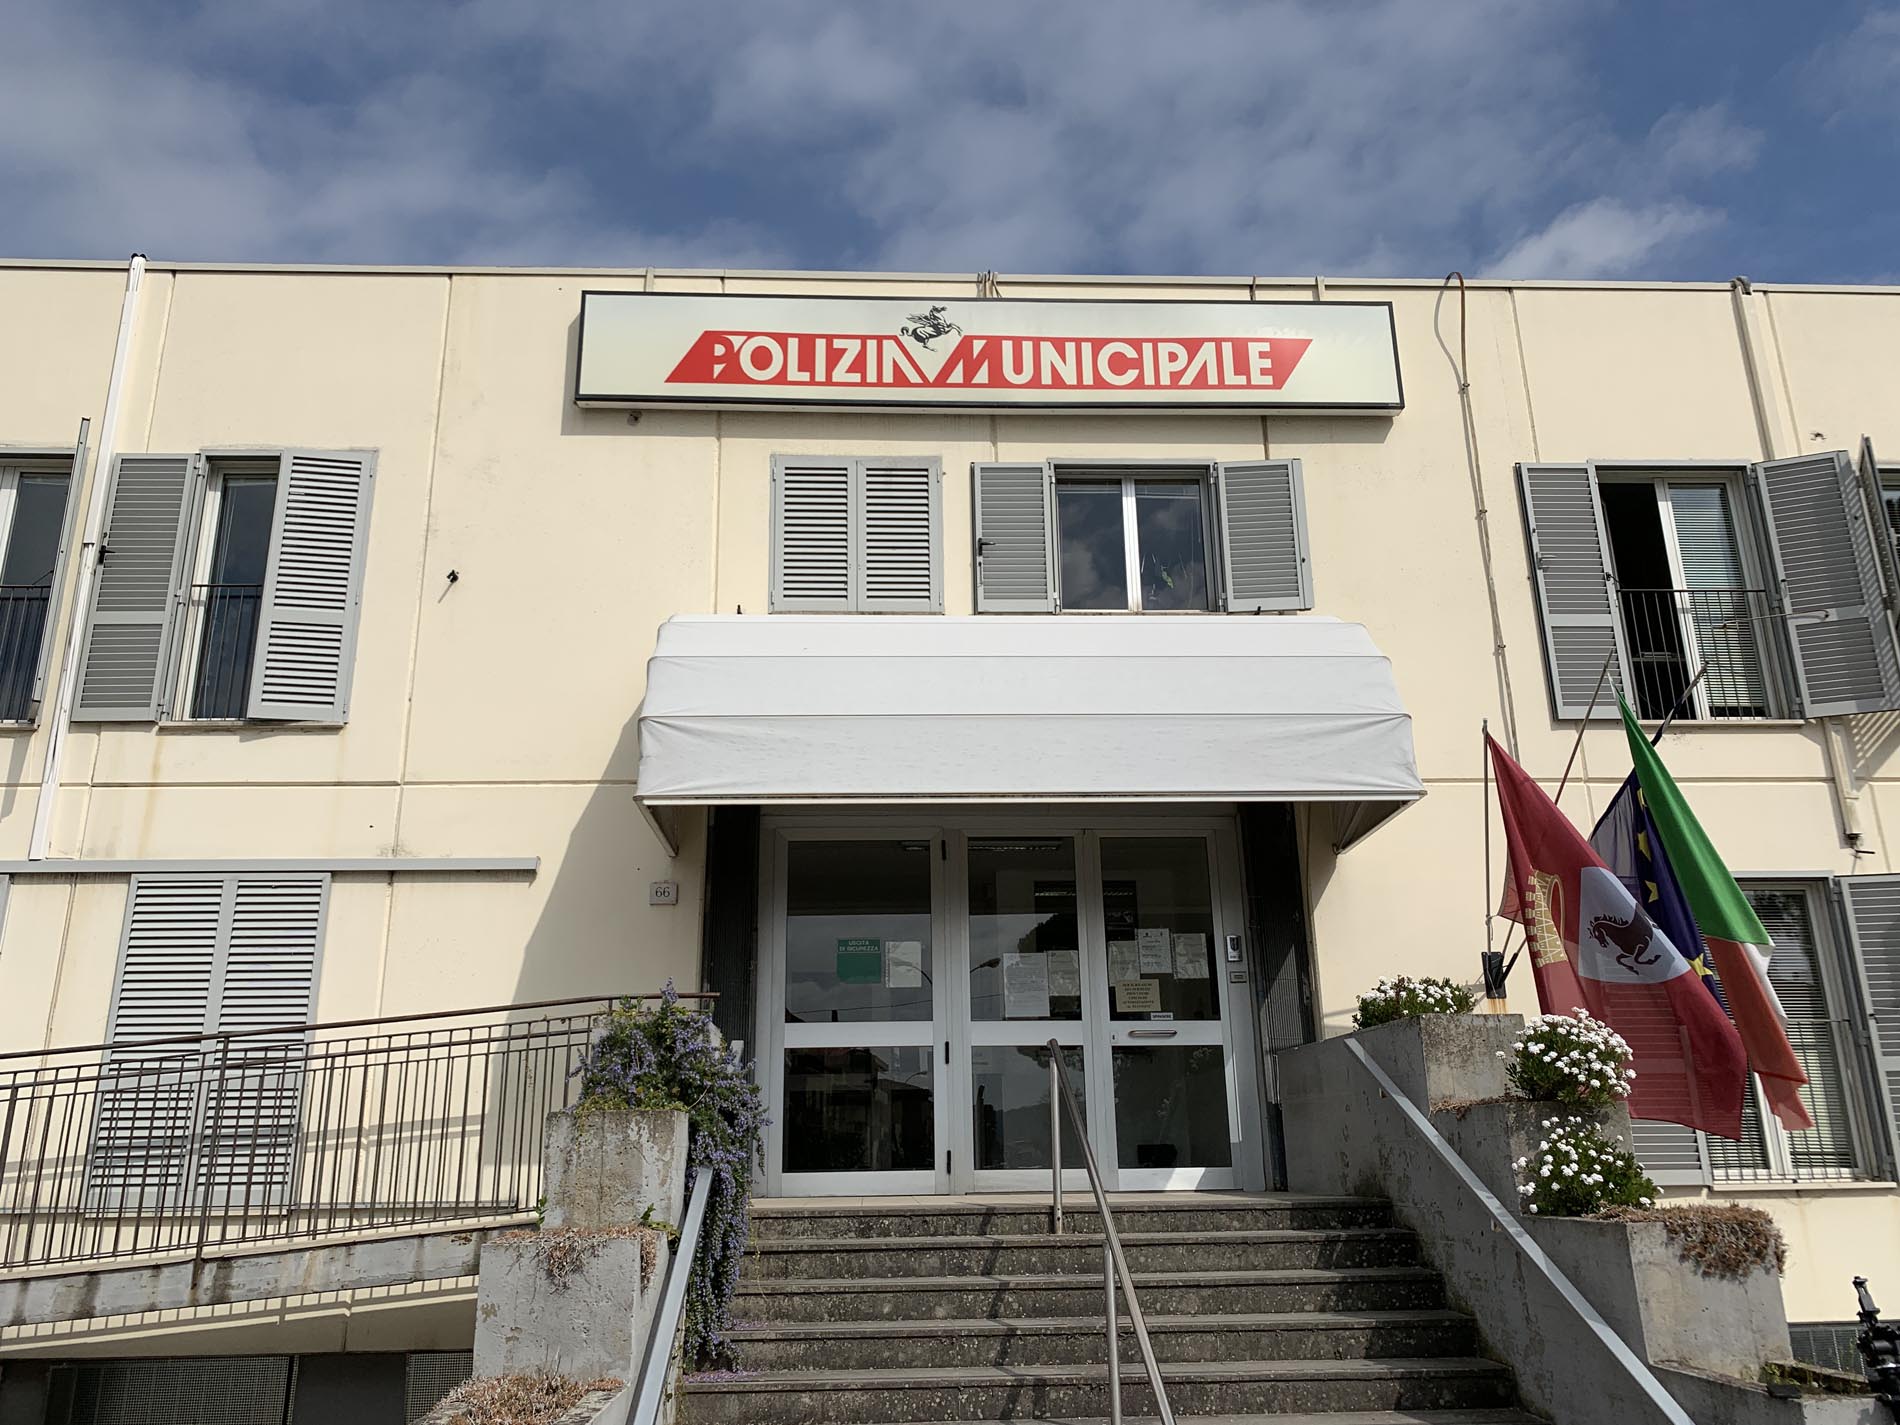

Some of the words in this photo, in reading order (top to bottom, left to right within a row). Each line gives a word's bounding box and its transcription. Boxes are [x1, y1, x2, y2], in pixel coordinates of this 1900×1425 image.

[676, 331, 928, 387] POLIZIA
[934, 335, 1276, 389] MUNICIPALE
[655, 886, 671, 898] 66
